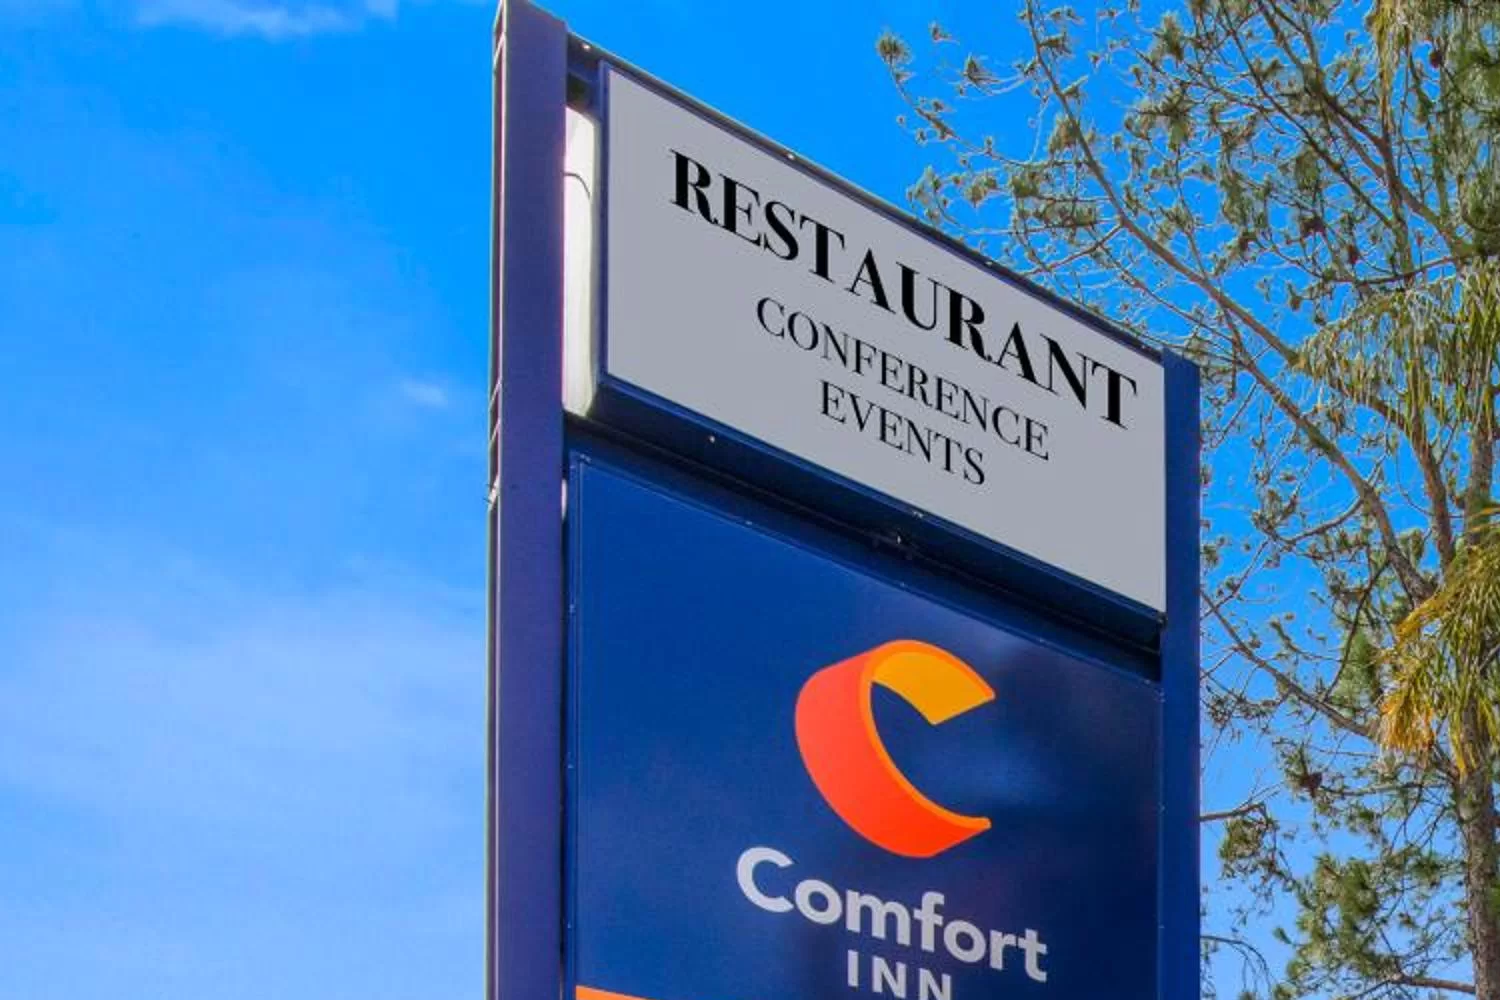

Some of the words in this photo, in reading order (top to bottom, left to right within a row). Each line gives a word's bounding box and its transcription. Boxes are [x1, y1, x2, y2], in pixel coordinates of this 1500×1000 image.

[669, 149, 1138, 430] RESTAURANT
[756, 296, 1050, 461] CONFERENCE
[820, 380, 986, 486] EVENTS
[735, 846, 1048, 983] Comfort
